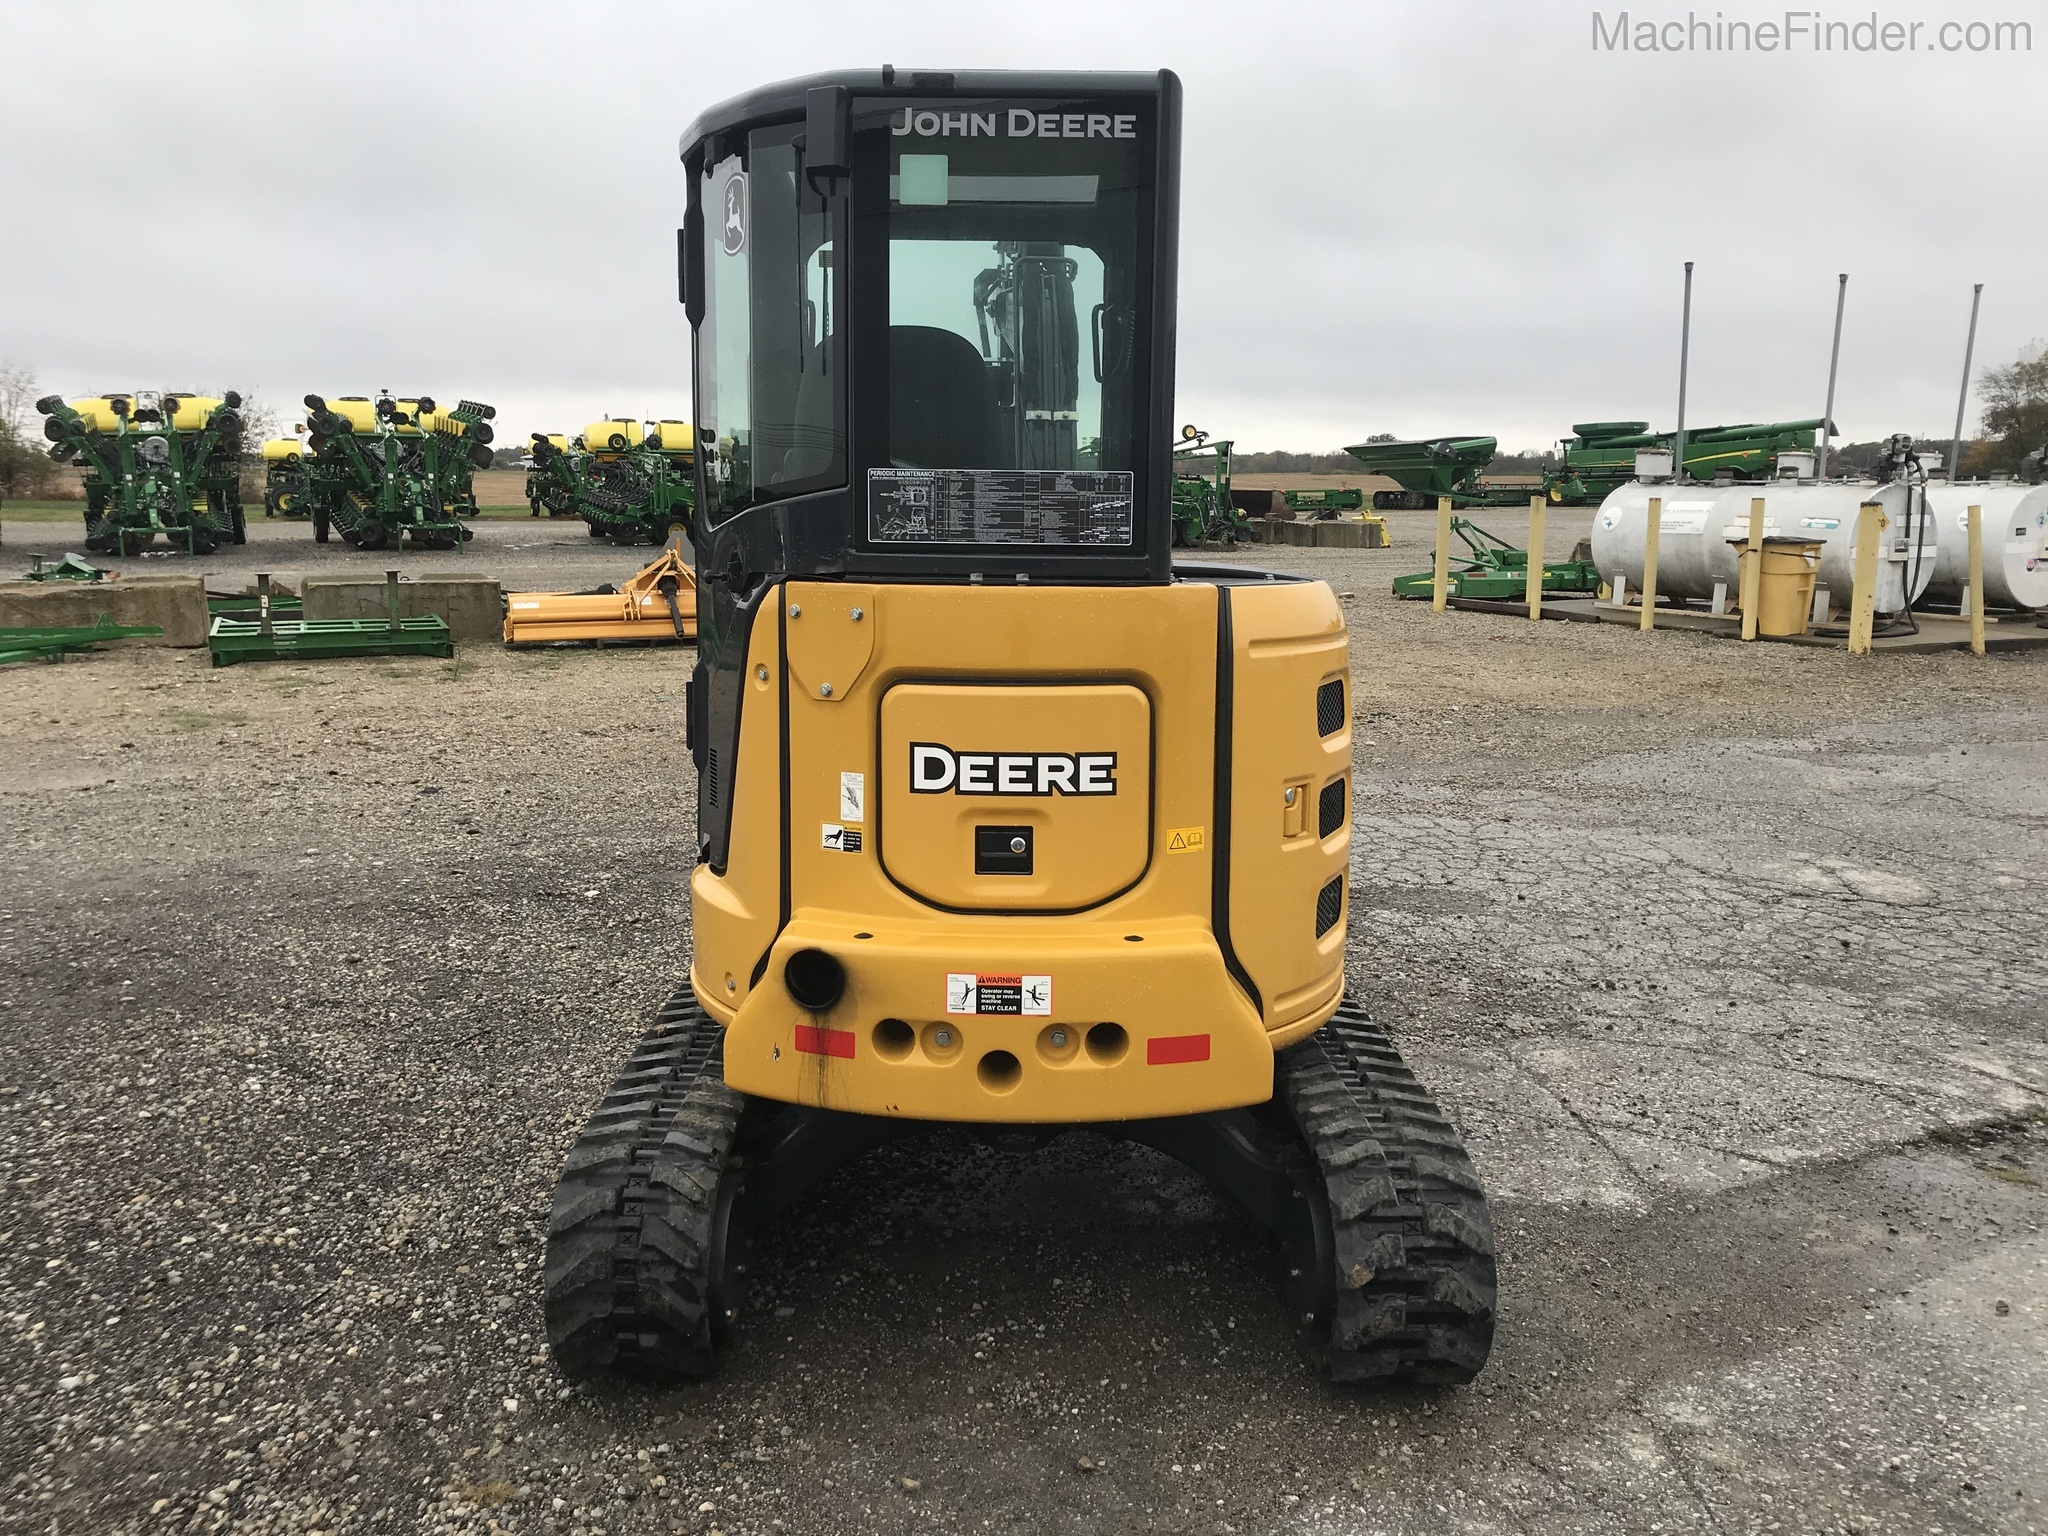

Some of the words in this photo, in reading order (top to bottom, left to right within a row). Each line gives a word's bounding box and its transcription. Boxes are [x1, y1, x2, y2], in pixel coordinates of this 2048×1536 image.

[892, 107, 997, 137] JOHN
[1008, 108, 1137, 139] DEERE
[911, 743, 1116, 795] DEERE
